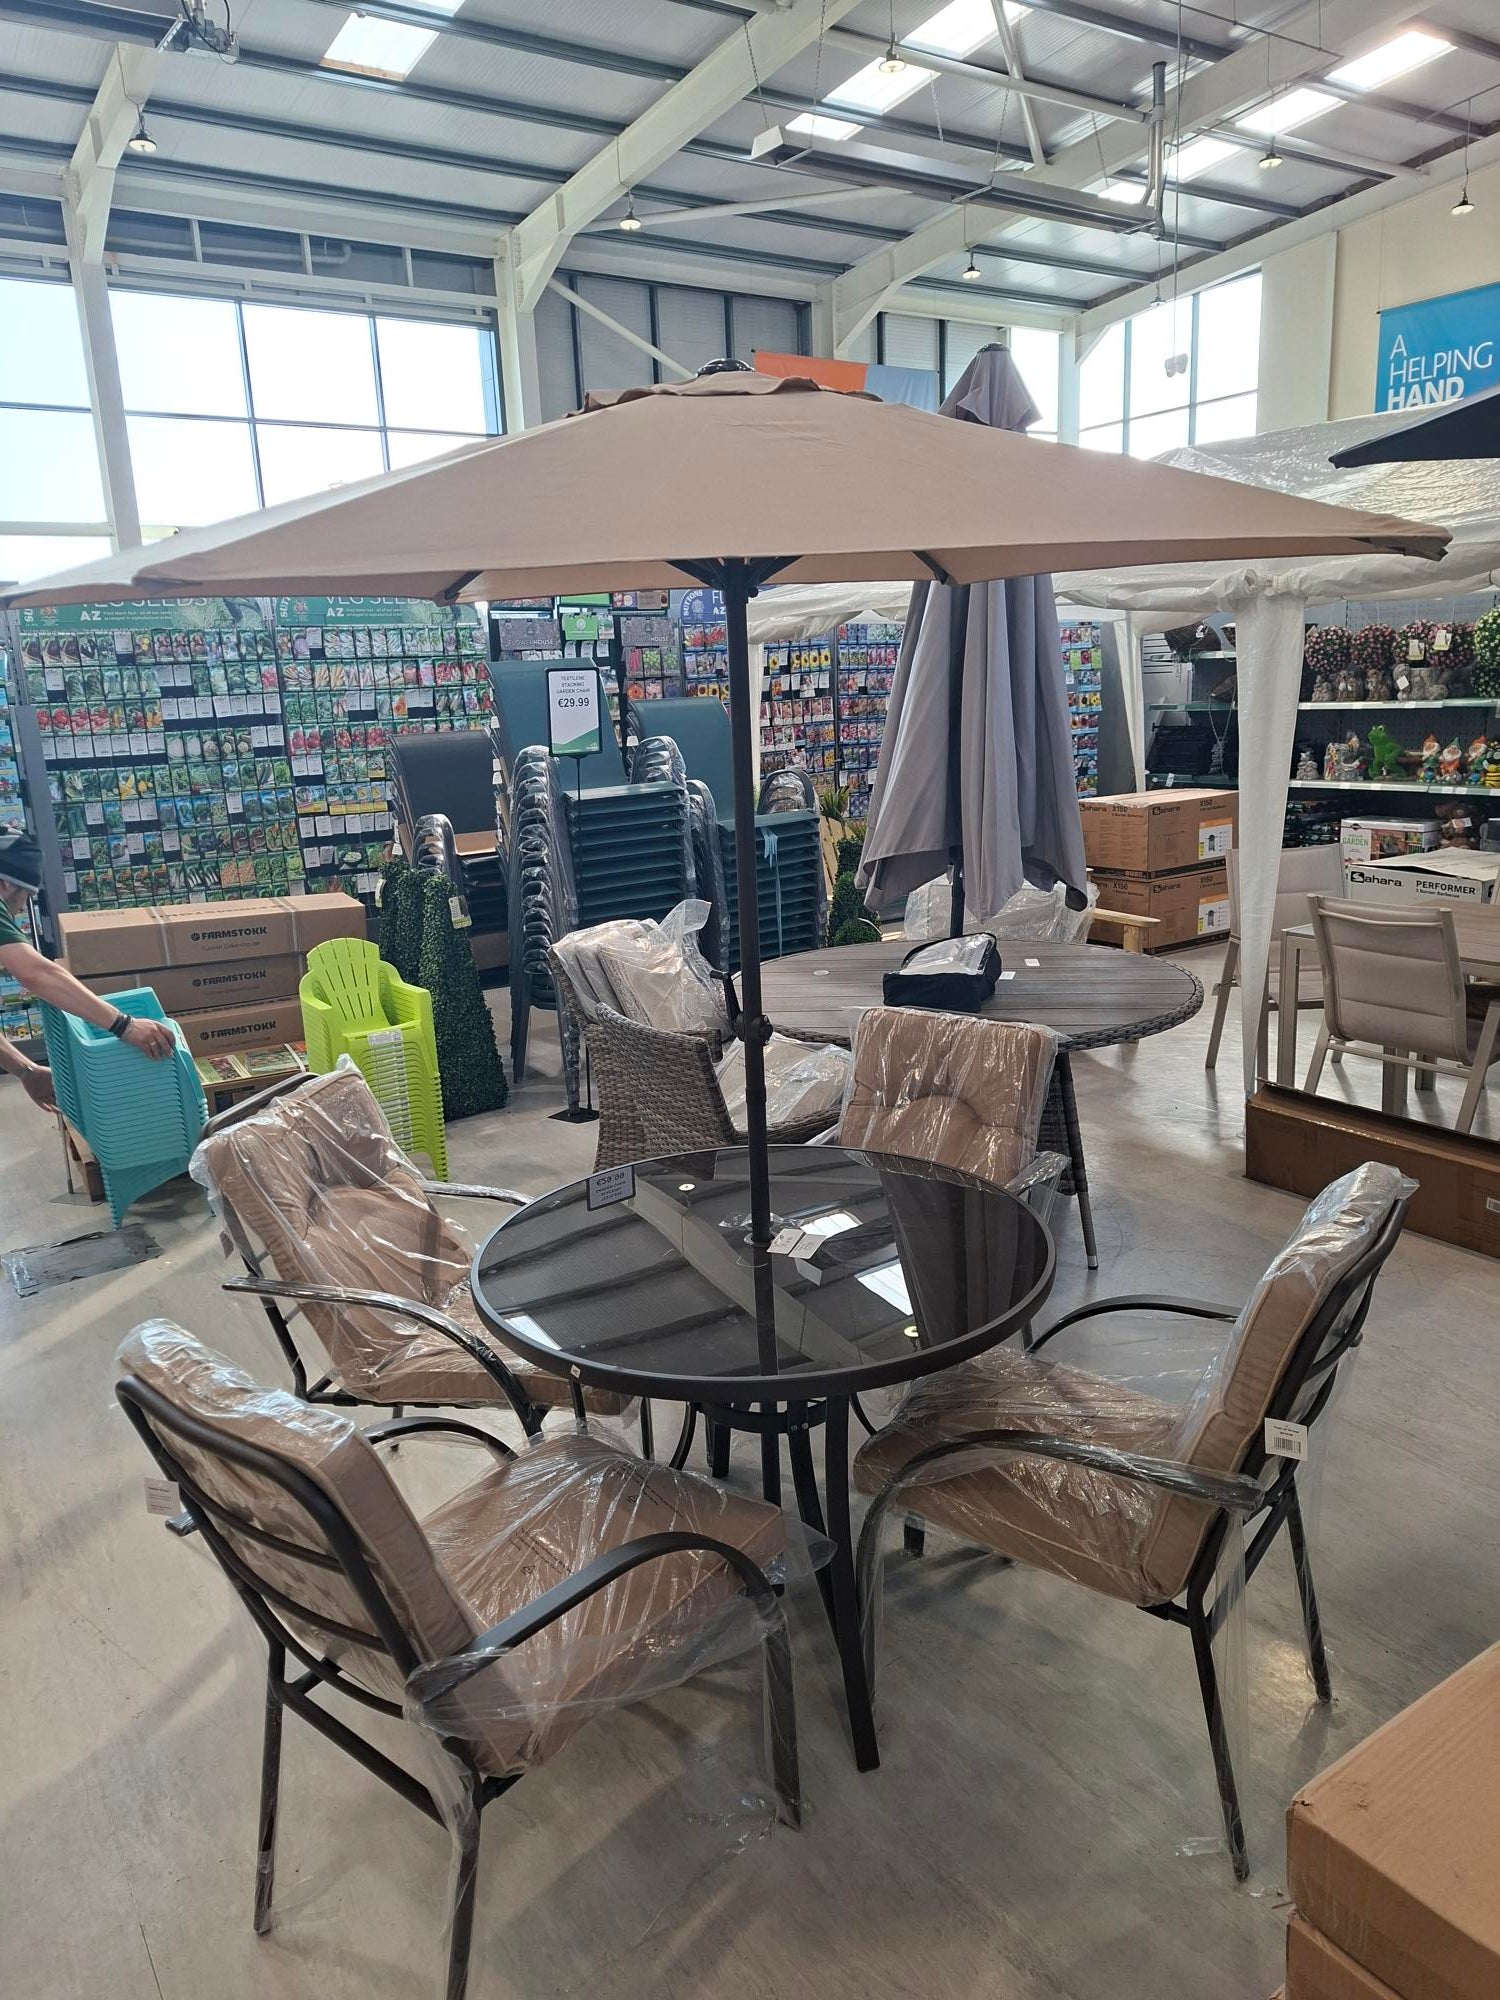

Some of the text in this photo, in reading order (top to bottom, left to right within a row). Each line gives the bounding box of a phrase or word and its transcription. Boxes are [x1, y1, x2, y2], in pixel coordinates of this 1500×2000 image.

[1390, 334, 1407, 360] A
[1390, 341, 1493, 386] HELPING
[1387, 376, 1465, 411] HAND
[80, 610, 102, 621] AZ
[326, 607, 345, 617] AZ
[557, 697, 590, 708] €29.99
[1350, 871, 1403, 887] Sahara
[1416, 880, 1476, 895] PERFORMER
[201, 926, 267, 940] FARMSTOKK
[202, 970, 267, 986] FARMSTOKK
[210, 1021, 276, 1038] FARMSTOKK
